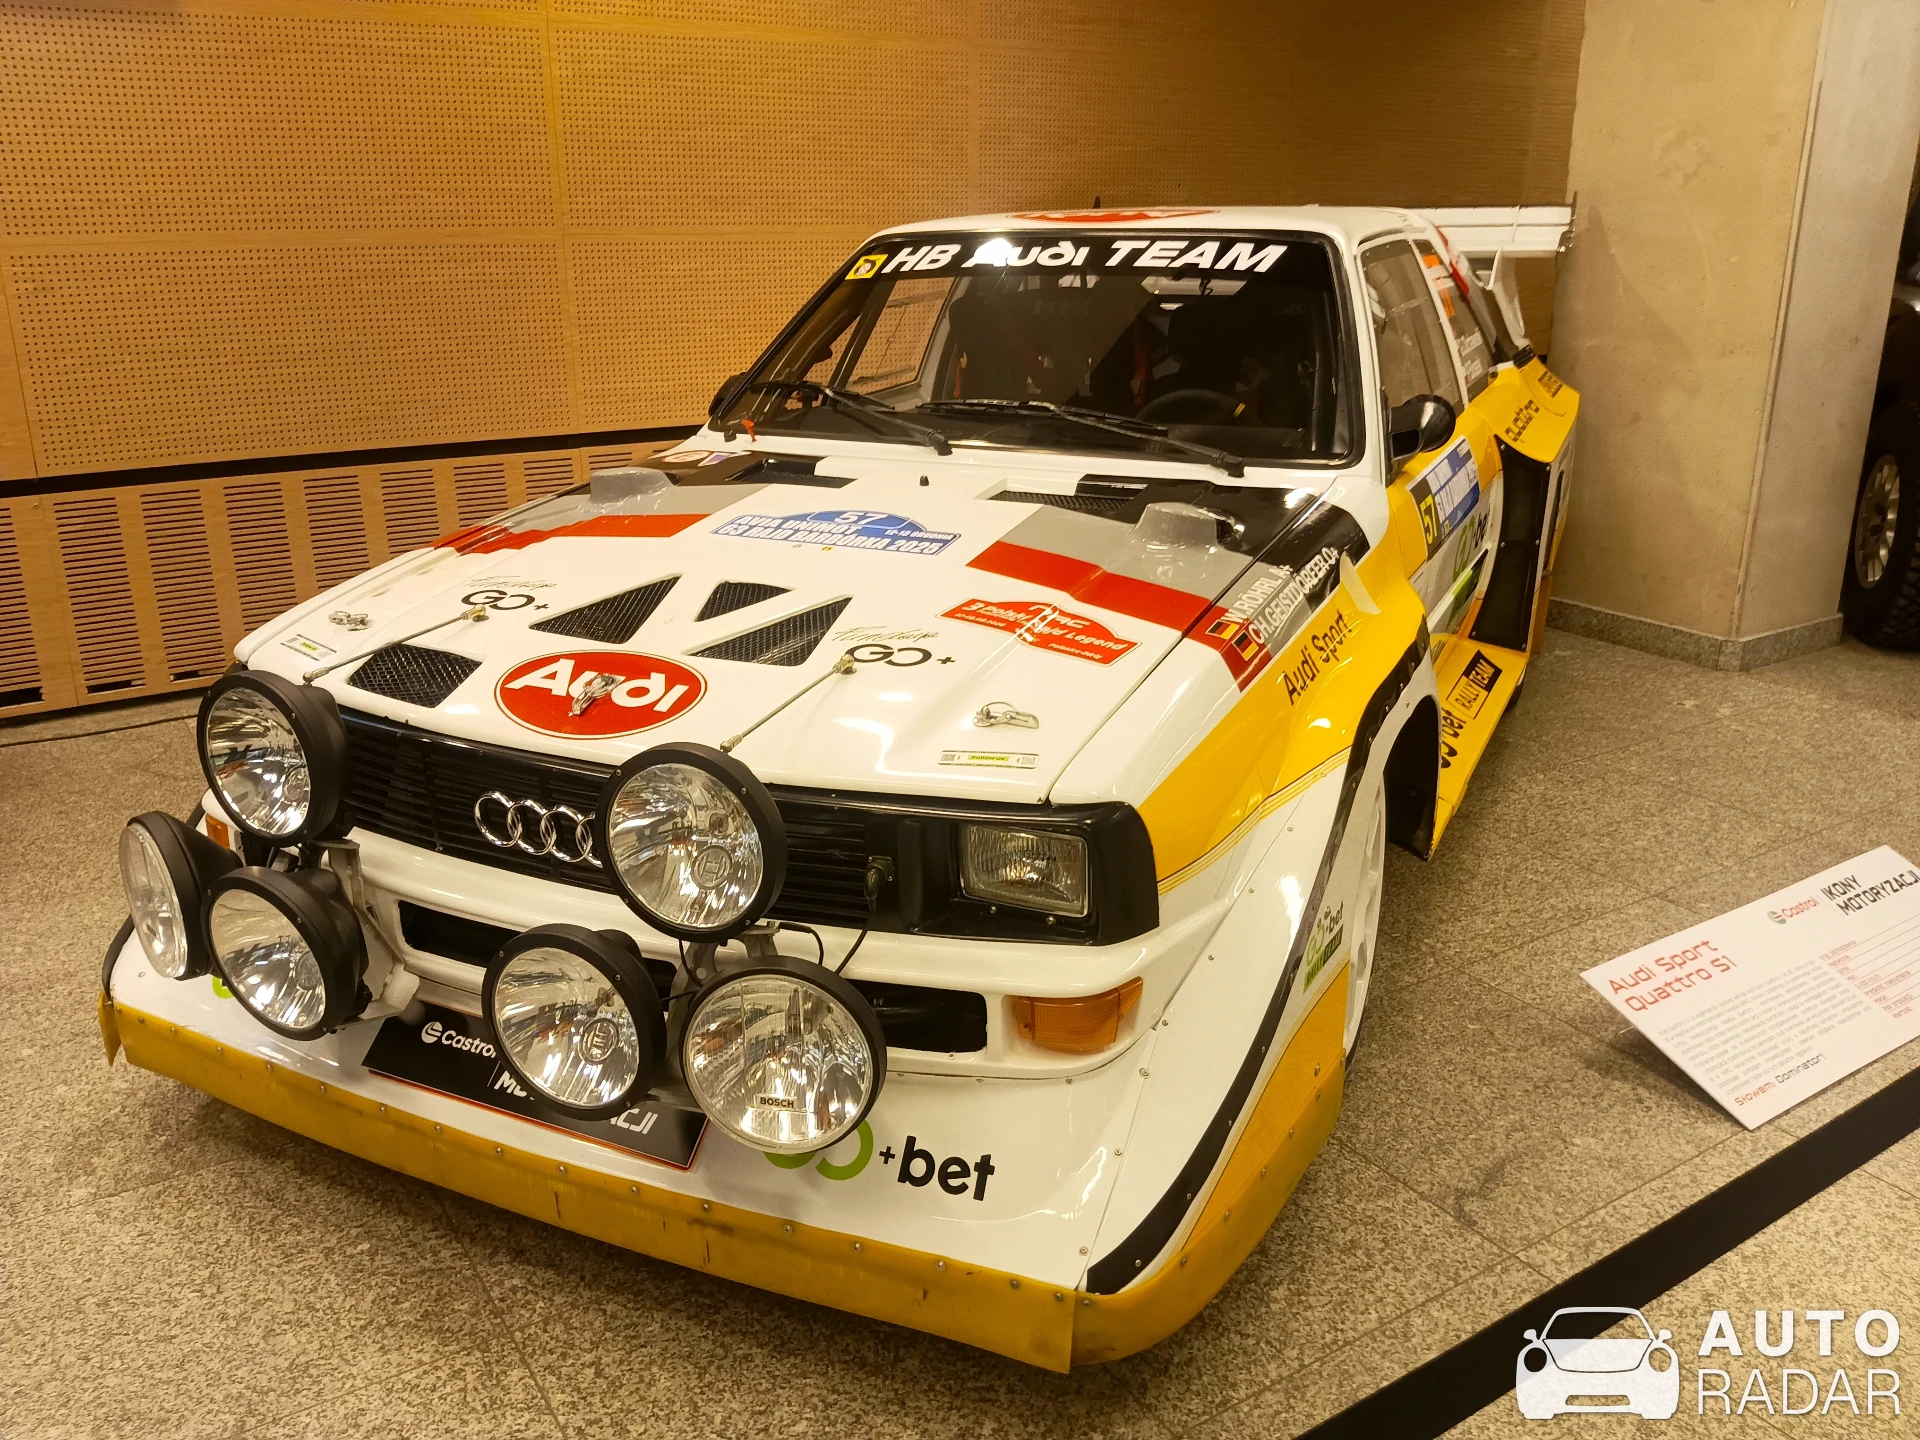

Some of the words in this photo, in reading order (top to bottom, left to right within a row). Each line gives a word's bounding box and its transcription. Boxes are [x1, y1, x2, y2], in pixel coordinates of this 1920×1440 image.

[880, 244, 961, 274] HB
[1104, 240, 1288, 273] TEAM
[733, 515, 784, 528] AVIA
[781, 519, 863, 535] UNIMOT
[833, 511, 889, 525] 57
[1420, 494, 1438, 545] 57
[741, 526, 795, 540] RAJD
[886, 539, 944, 554] 2025
[1064, 632, 1129, 650] Legend
[1282, 645, 1320, 706] Audi
[1311, 609, 1353, 663] Sport
[504, 658, 690, 713] Audi
[1820, 874, 1862, 901] IKONY
[1781, 896, 1820, 918] Castrol
[1608, 964, 1657, 995] Audi
[1654, 940, 1718, 973] Sport
[1624, 968, 1713, 1012] Quattro
[1710, 955, 1738, 973] S1
[759, 1096, 795, 1109] BOSCH
